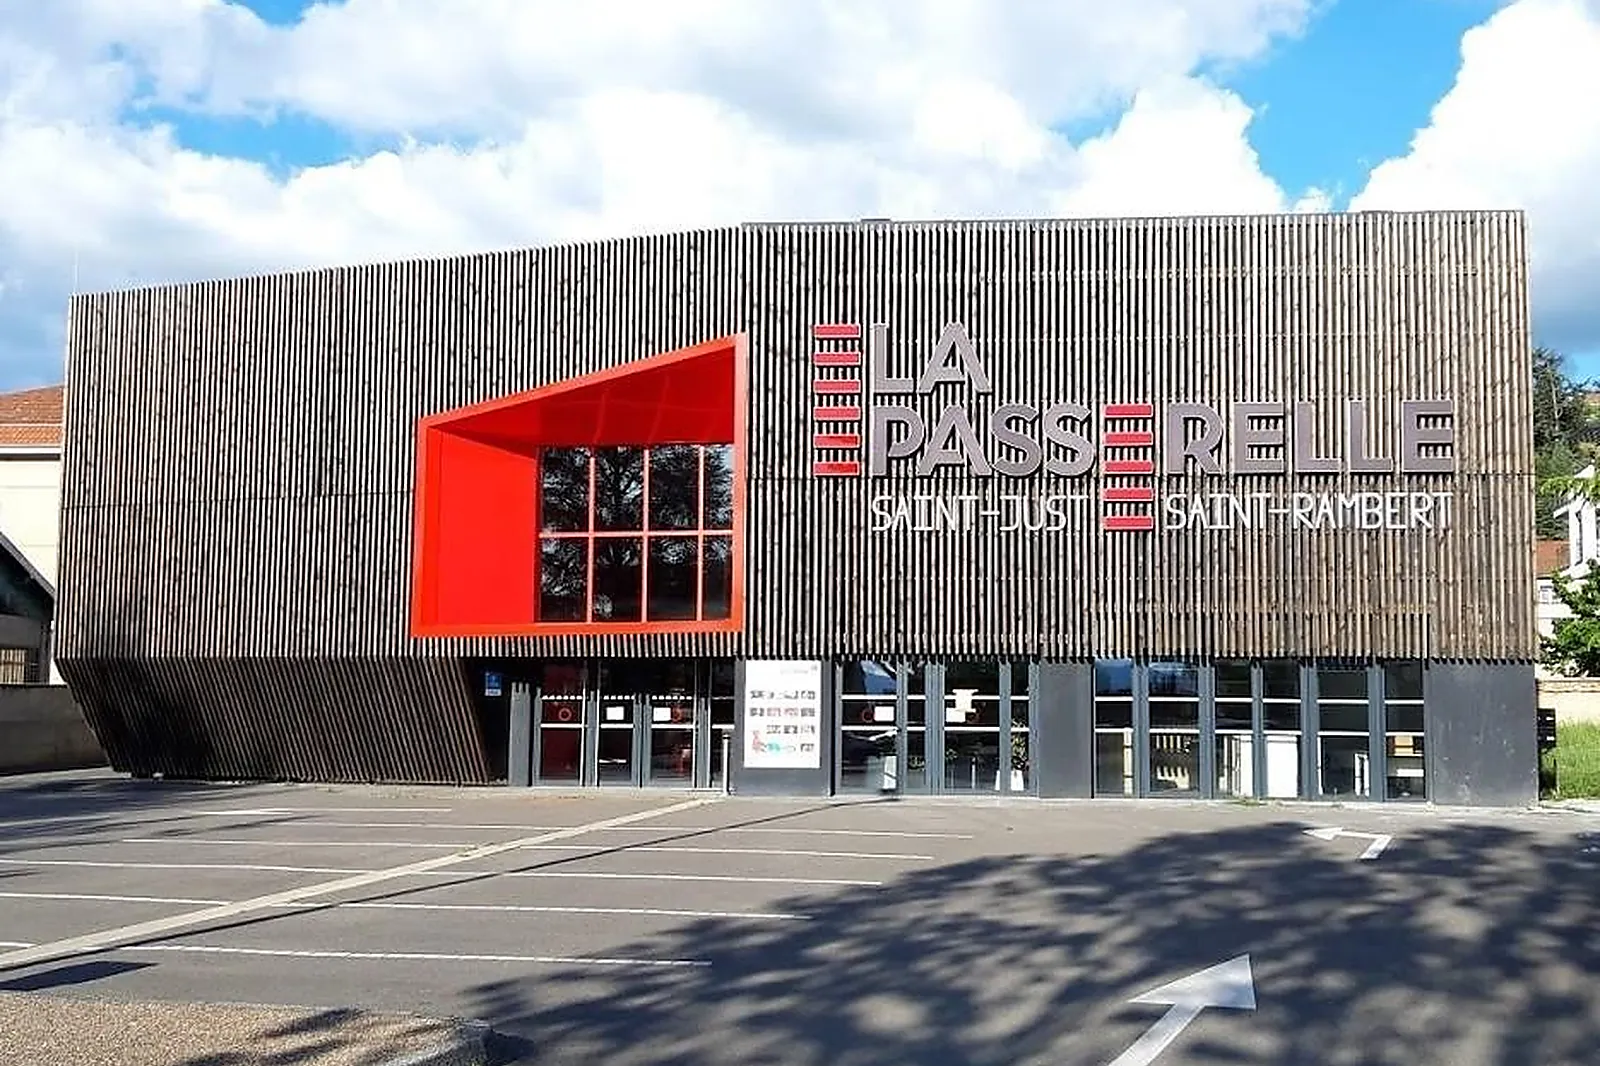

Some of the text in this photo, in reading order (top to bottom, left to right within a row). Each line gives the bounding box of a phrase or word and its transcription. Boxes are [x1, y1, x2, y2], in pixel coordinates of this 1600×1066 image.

[871, 322, 992, 394] LA
[870, 401, 1454, 477] PASSERELLE
[871, 492, 1454, 532] SAINT-JUST SAINT-RAMBERT
